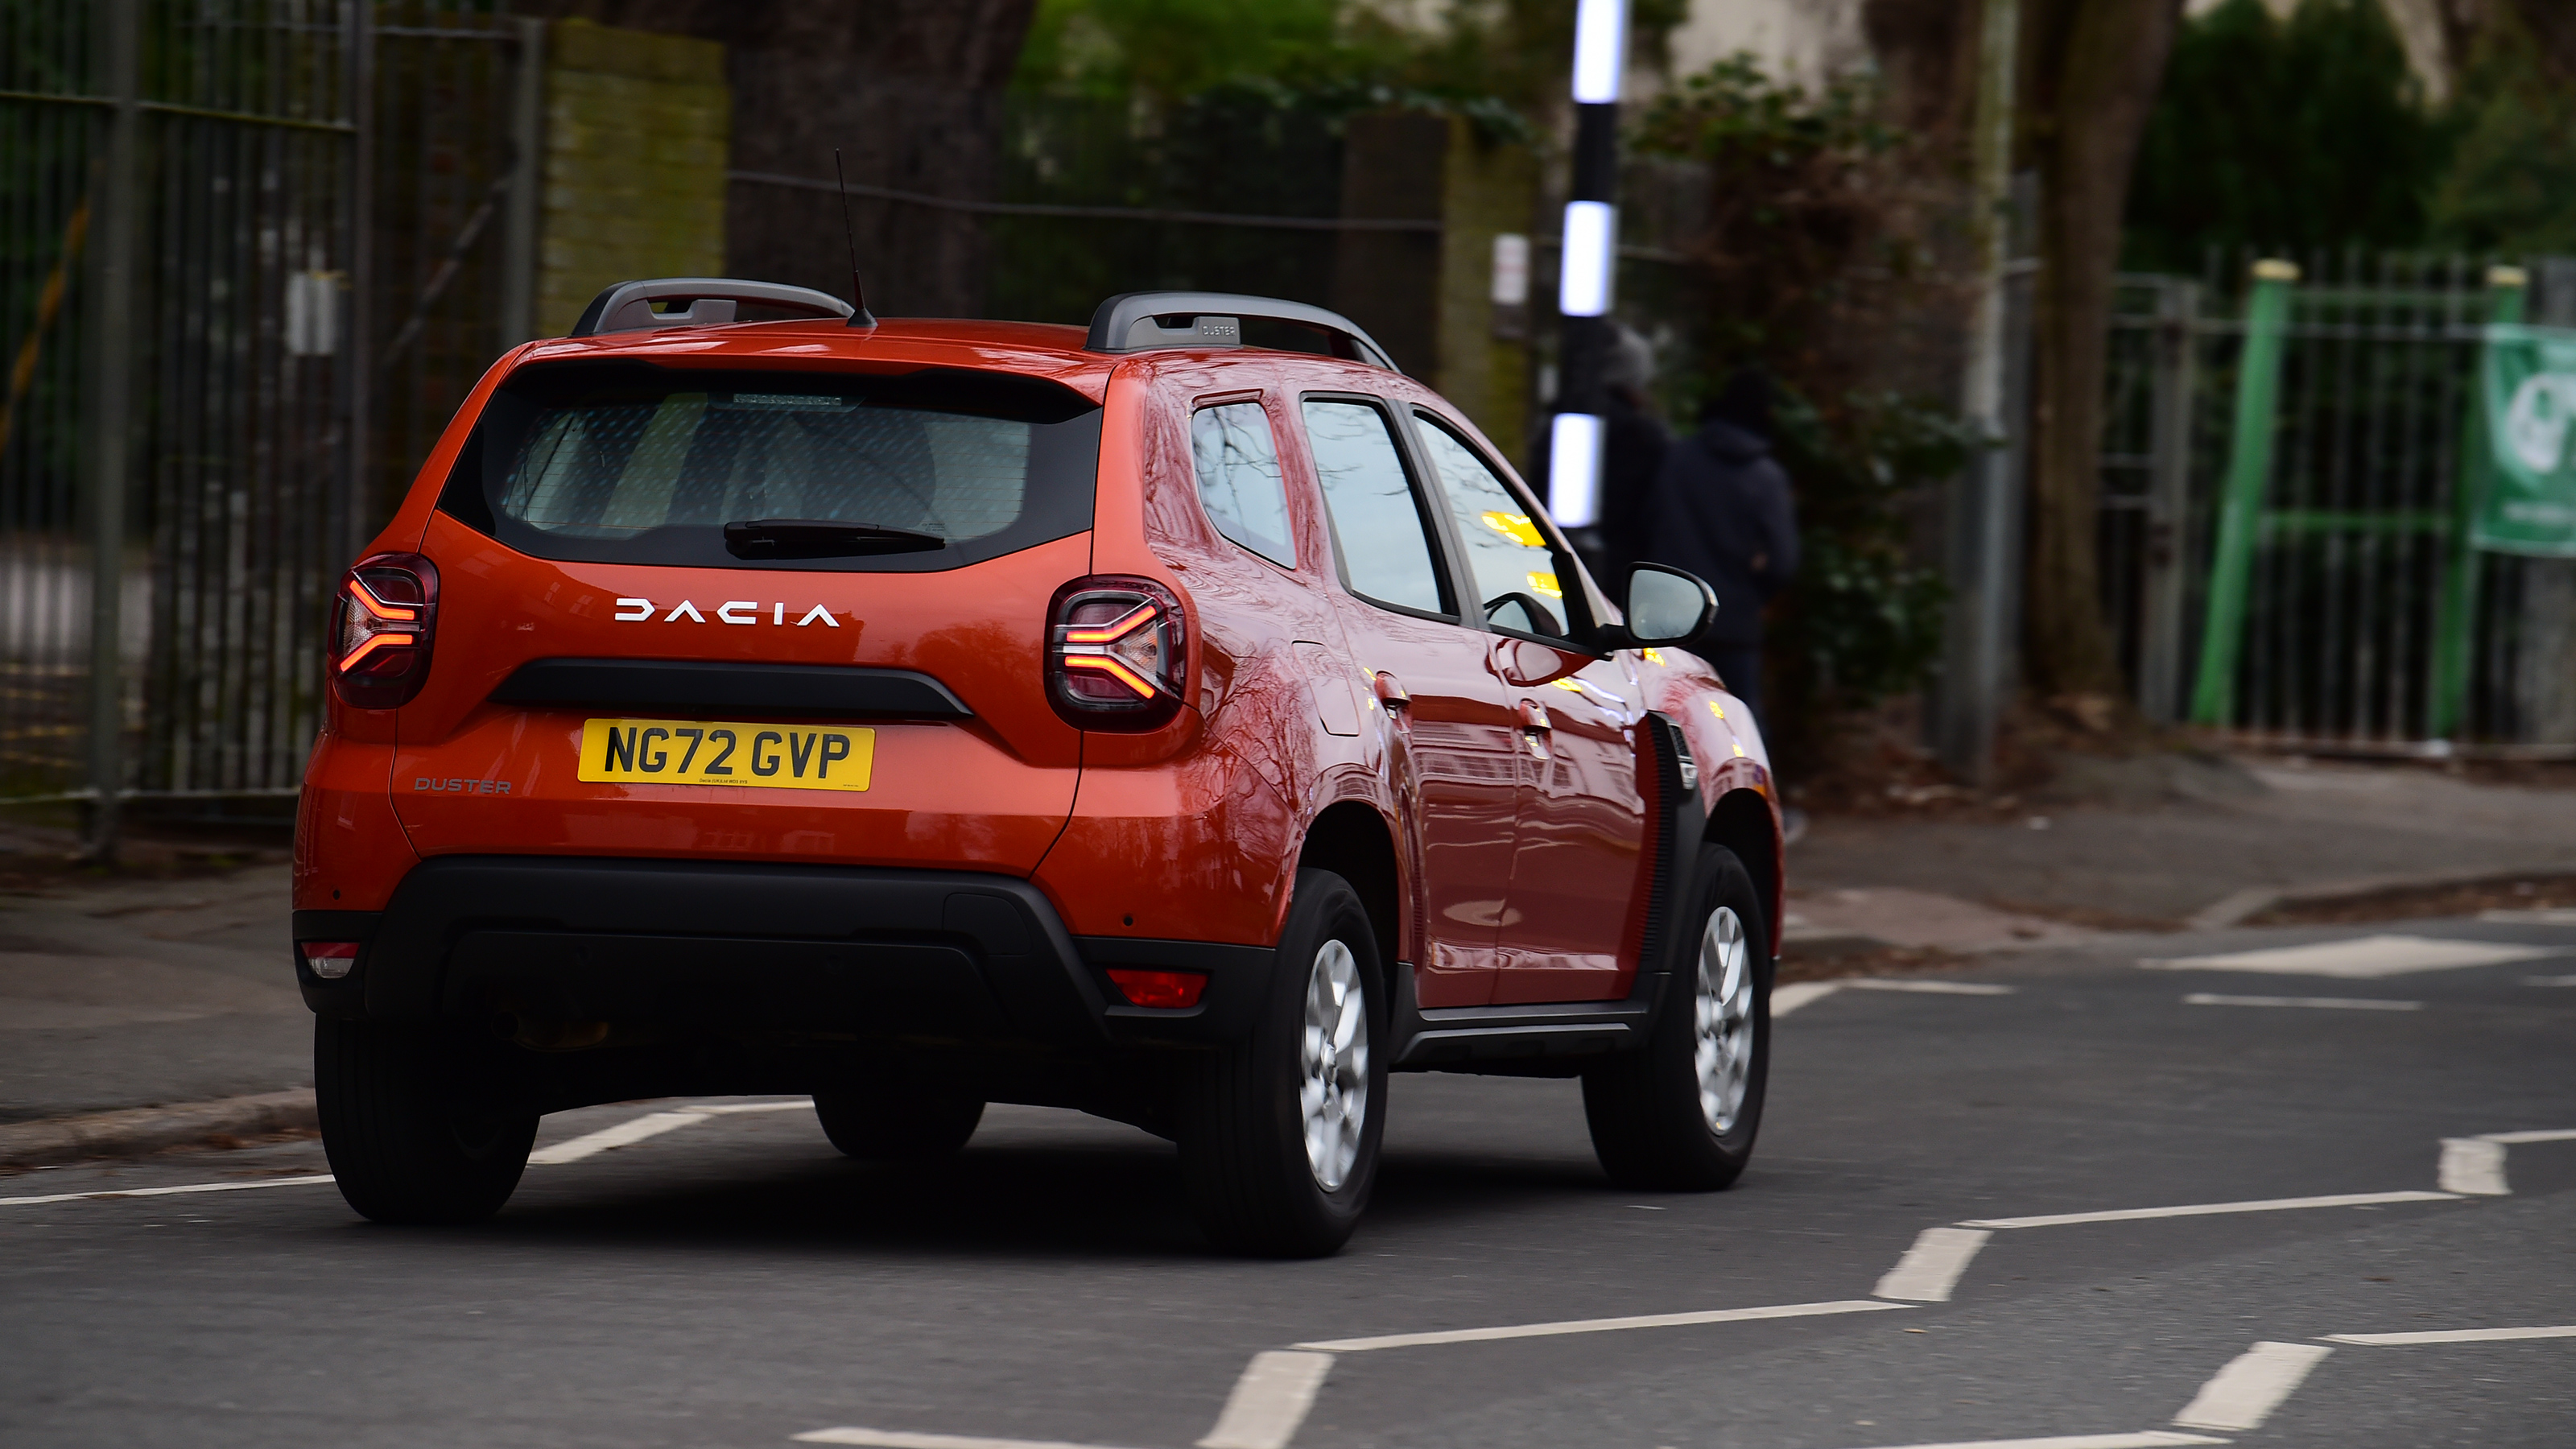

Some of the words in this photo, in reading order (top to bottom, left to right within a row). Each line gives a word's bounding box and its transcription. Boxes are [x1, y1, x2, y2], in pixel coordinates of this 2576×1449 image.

[1202, 325, 1235, 336] DUSTER
[614, 597, 840, 627] DACIA
[605, 726, 737, 775] NG72
[751, 731, 851, 778] GVP
[414, 778, 511, 795] DUSTER
